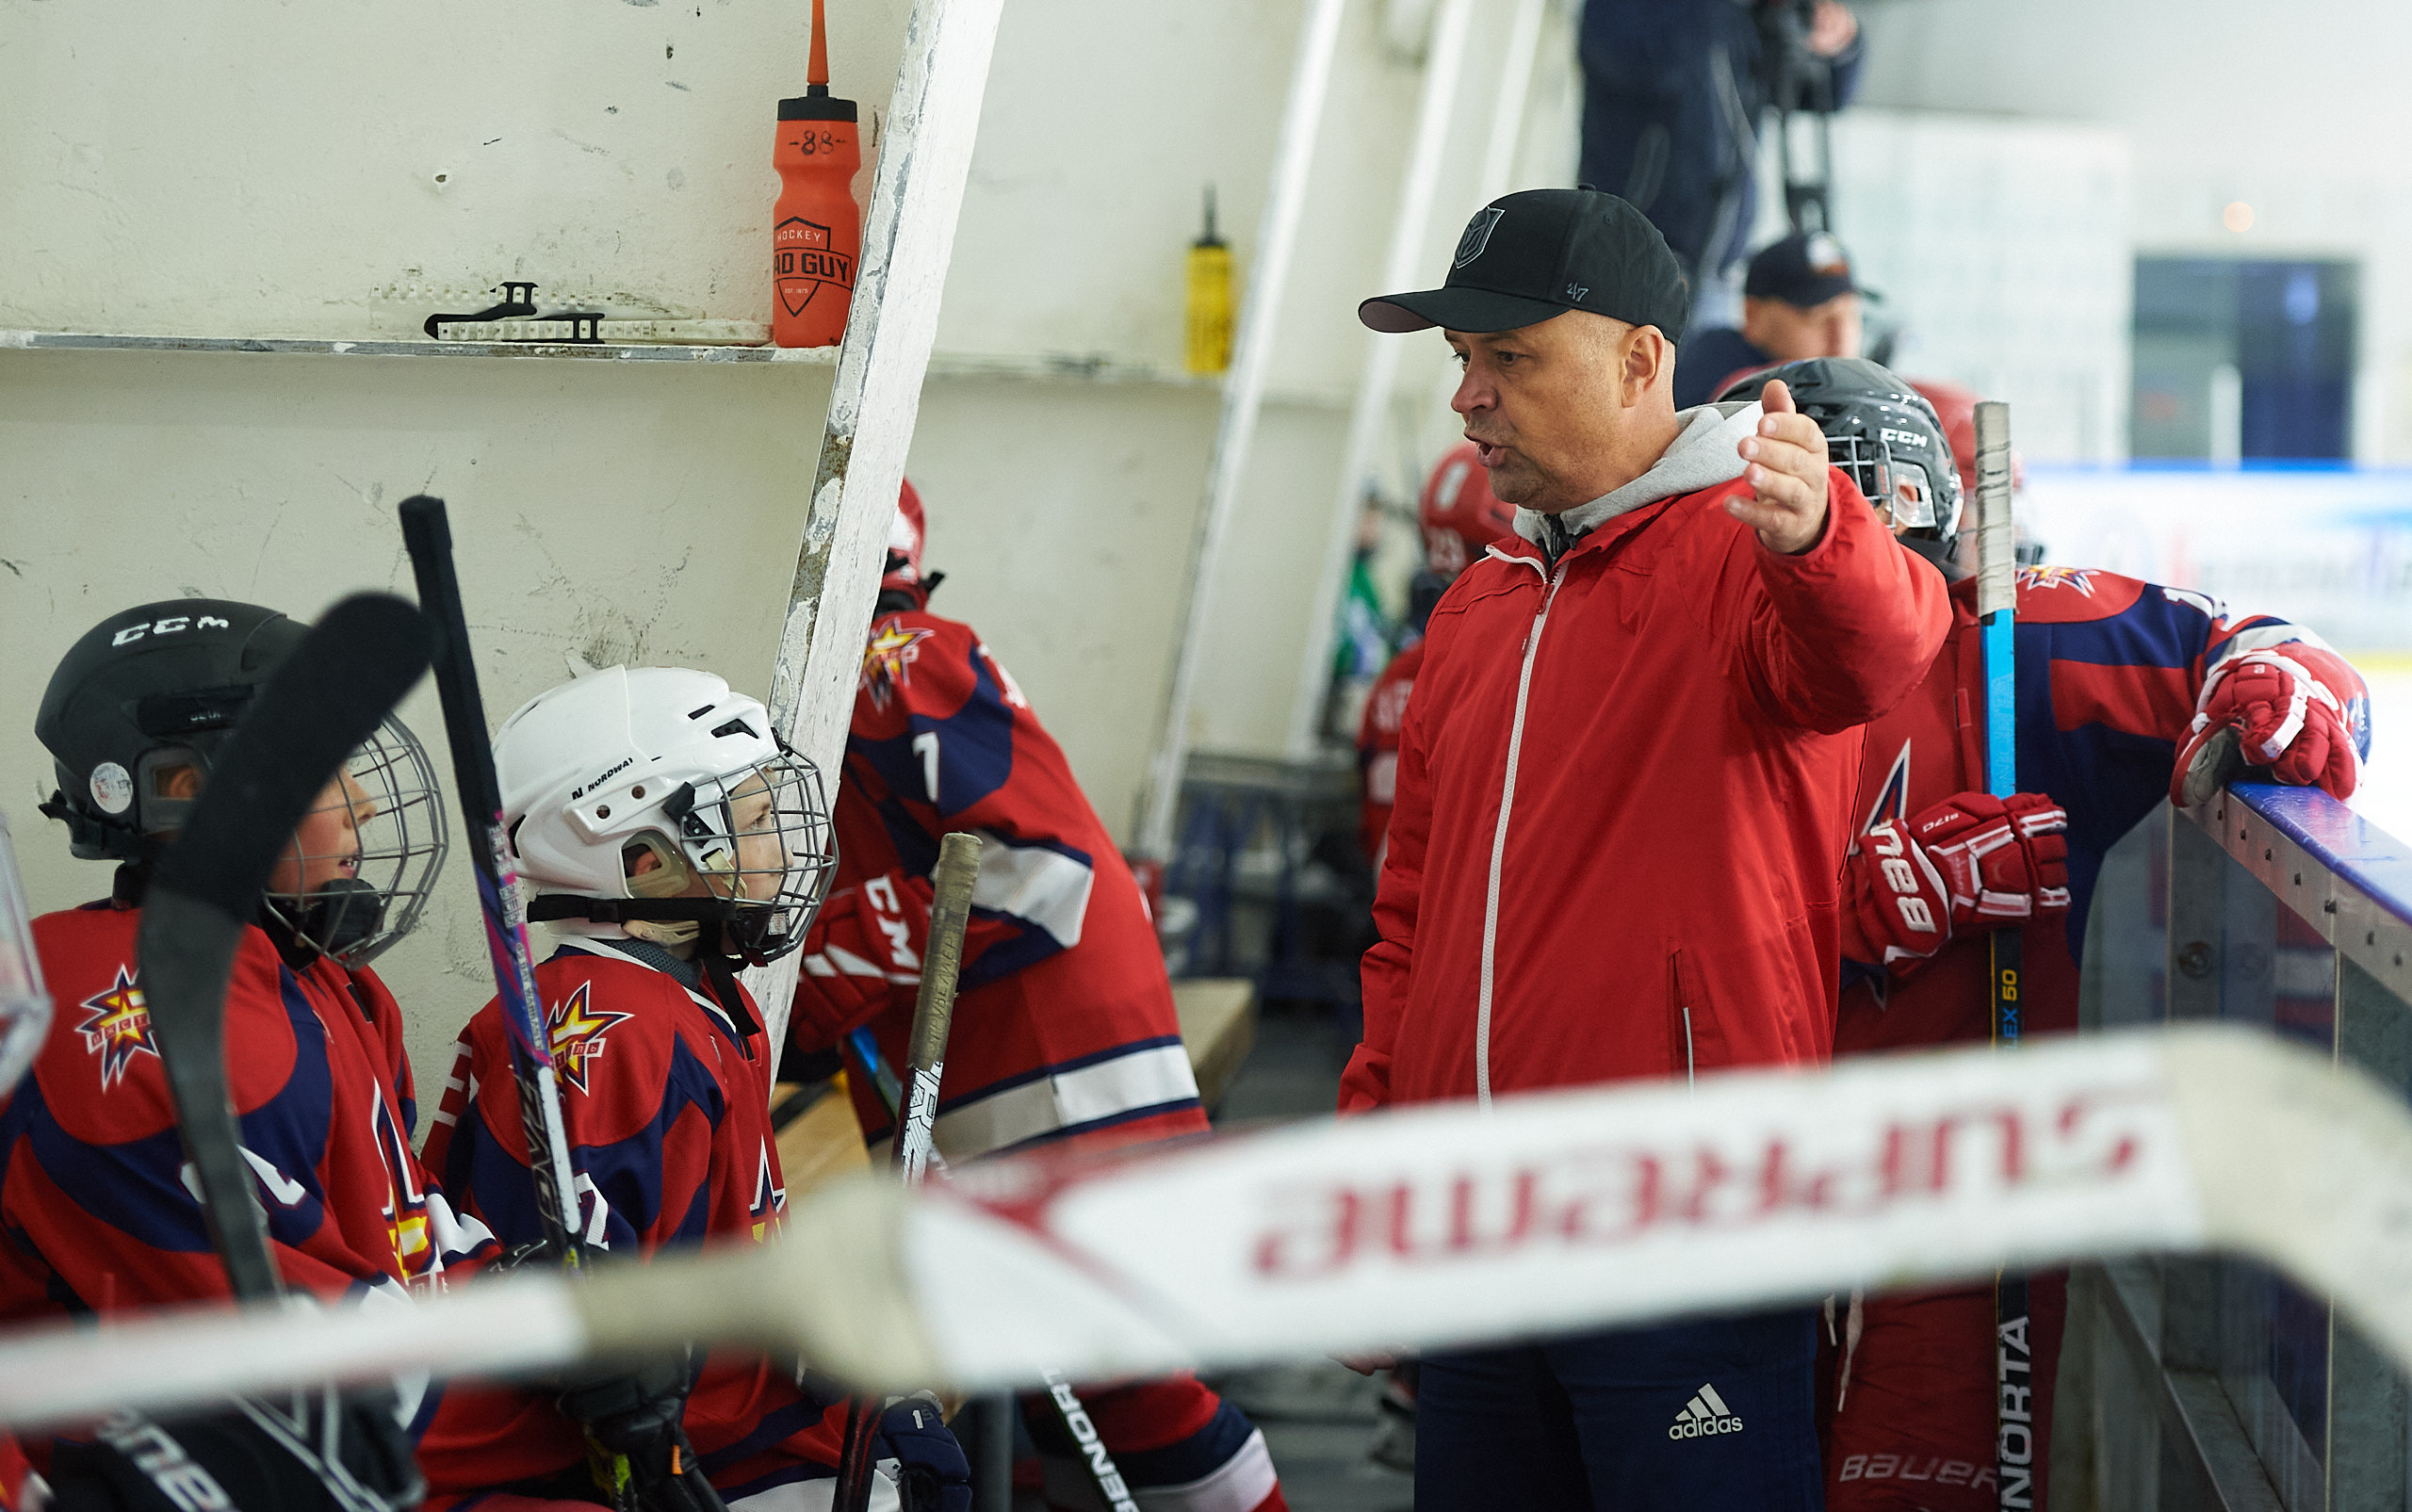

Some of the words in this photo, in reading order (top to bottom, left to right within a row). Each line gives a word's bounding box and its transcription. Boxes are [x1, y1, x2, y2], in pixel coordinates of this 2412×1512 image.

[777, 229, 821, 242] HOCKEY
[774, 252, 794, 276] AD
[801, 252, 849, 283] GUY
[1880, 427, 1928, 447] CCM
[111, 615, 229, 646] CCM
[864, 873, 921, 970] CM
[2001, 968, 2017, 1001] 50
[1669, 1415, 1744, 1440] adidas
[1996, 1315, 2033, 1512] NORTA
